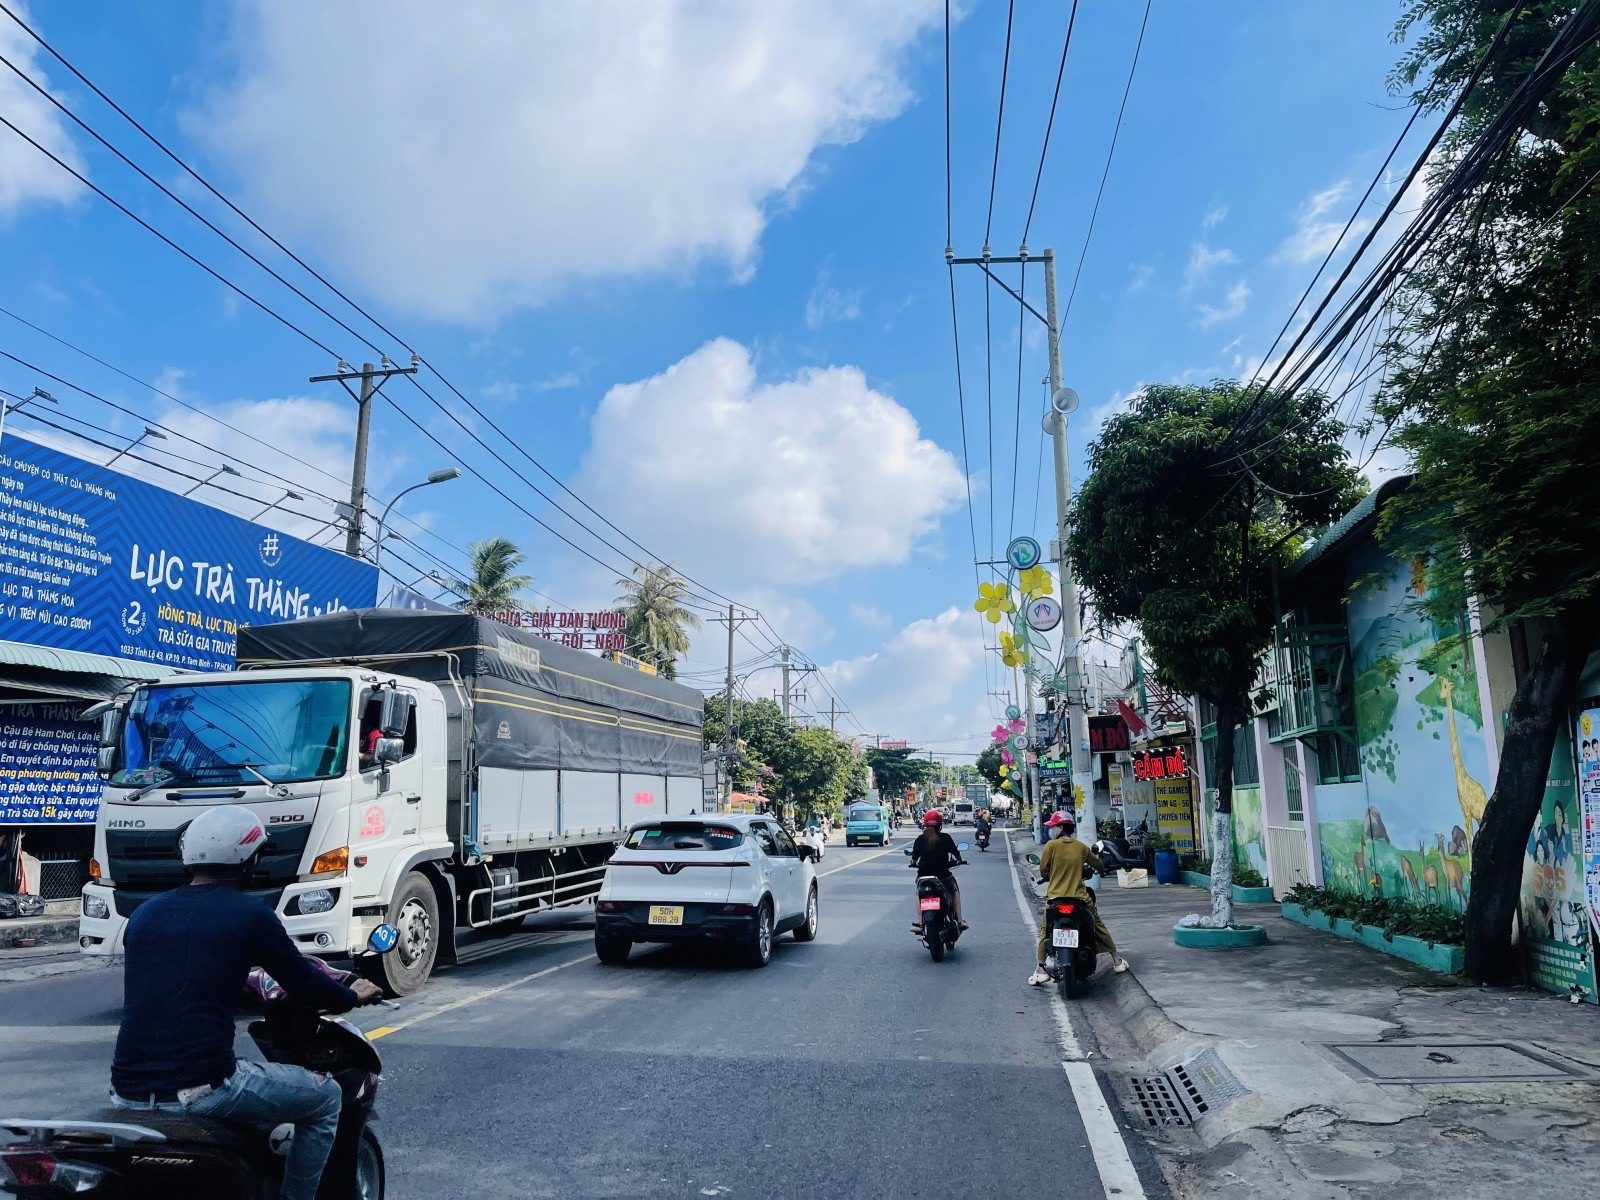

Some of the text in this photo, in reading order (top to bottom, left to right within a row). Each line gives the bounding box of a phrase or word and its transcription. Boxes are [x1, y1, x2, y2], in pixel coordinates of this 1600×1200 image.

[130, 544, 184, 594] LỤC
[192, 563, 236, 605] TRÀ
[246, 578, 310, 620] THĂNG
[61, 594, 74, 608] HOA
[158, 602, 185, 624] HỒNG
[206, 616, 221, 633] LỤC
[158, 627, 174, 644] TRÀ
[176, 630, 194, 648] SỮA
[196, 636, 210, 652] GIA
[4, 725, 20, 736] Cậu
[22, 726, 34, 736] Bé
[35, 728, 54, 738] Ham
[78, 731, 92, 741] Lớn
[9, 740, 18, 749] đi
[1, 754, 14, 763] Em
[16, 755, 41, 765] quyết
[43, 755, 60, 766] định
[18, 768, 52, 780] phương
[82, 771, 98, 782] một
[27, 782, 48, 793] được
[51, 783, 66, 794] bậc
[11, 795, 31, 804] thức
[33, 795, 45, 804] trà
[66, 796, 78, 804] Em
[7, 808, 20, 818] Trà
[22, 807, 39, 818] Sữa
[41, 805, 57, 818] 15k
[58, 808, 72, 819] gây
[74, 809, 94, 819] dựng
[270, 814, 304, 823] 500
[109, 820, 145, 828] HINO
